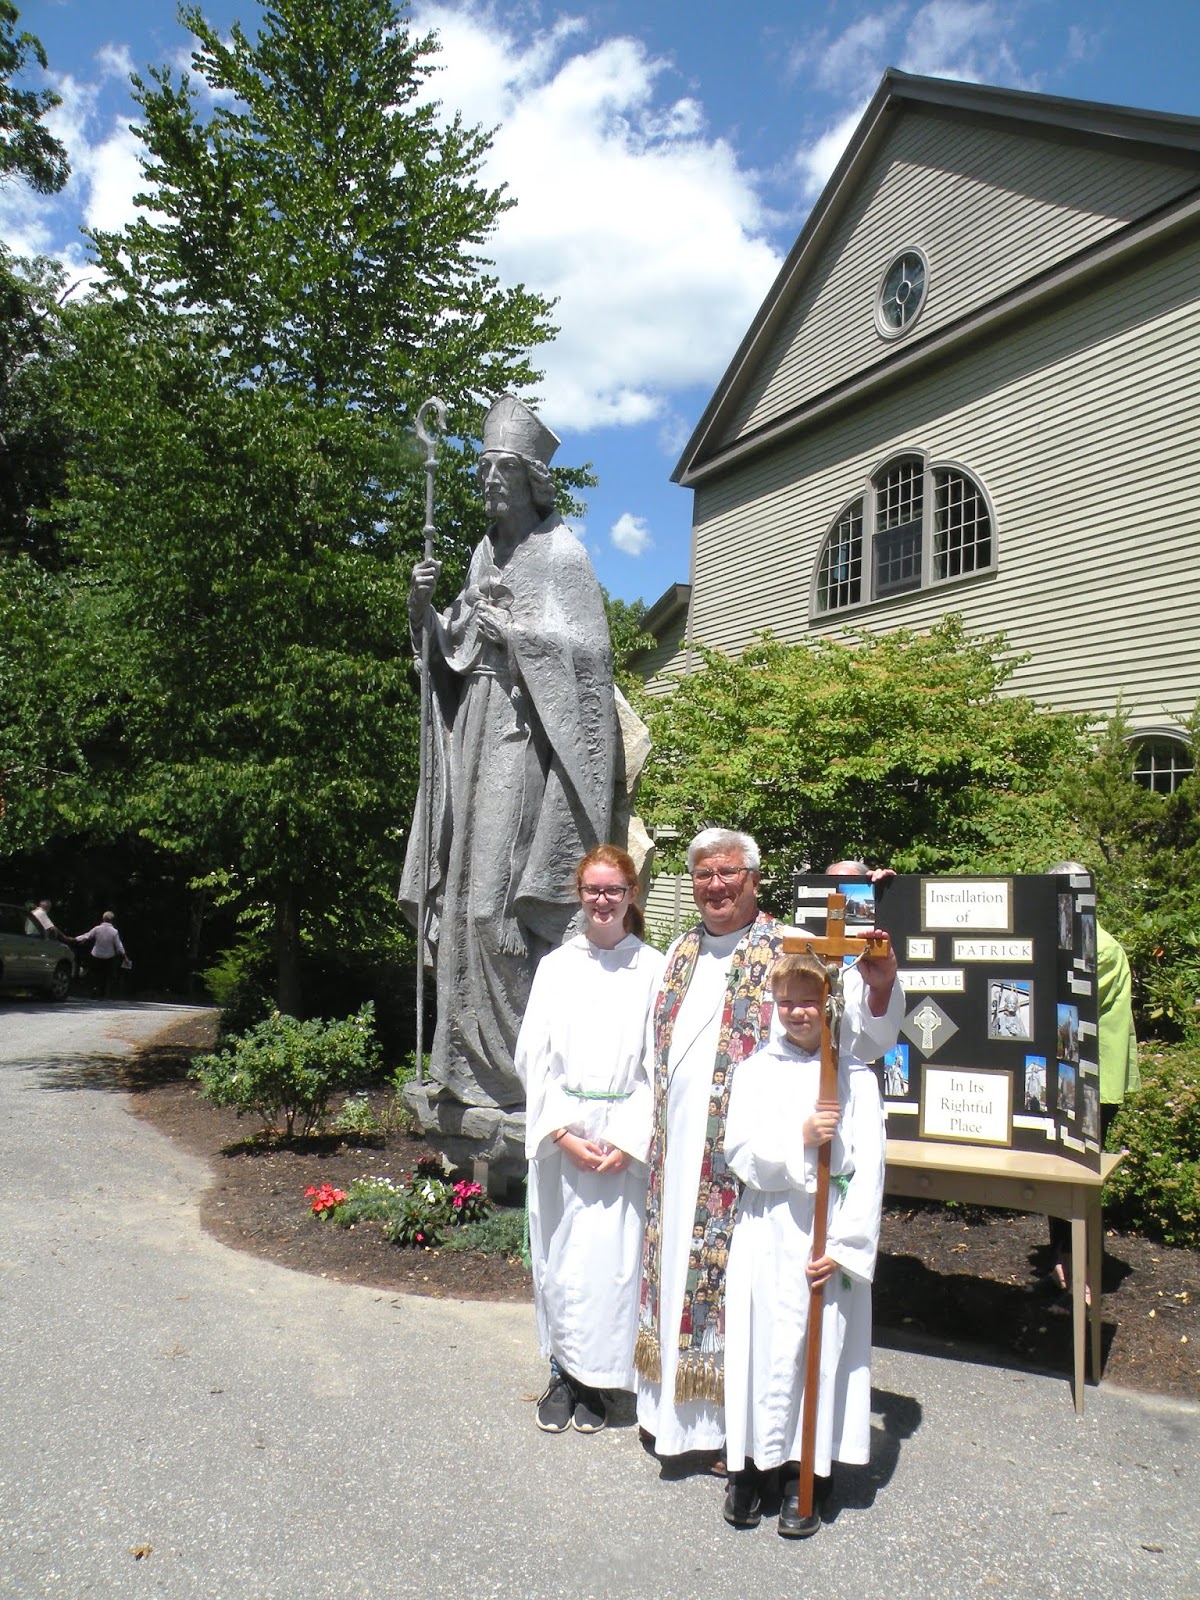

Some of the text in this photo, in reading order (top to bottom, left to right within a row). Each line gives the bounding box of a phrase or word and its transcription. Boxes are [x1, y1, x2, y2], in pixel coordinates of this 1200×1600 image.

[931, 889, 1004, 903] Installation
[956, 909, 971, 923] of
[911, 943, 1031, 957] ST. PATRICK
[899, 975, 962, 986] STATUE
[950, 1078, 985, 1093] In Its
[941, 1097, 993, 1115] Rightful
[950, 1118, 983, 1134] Place
